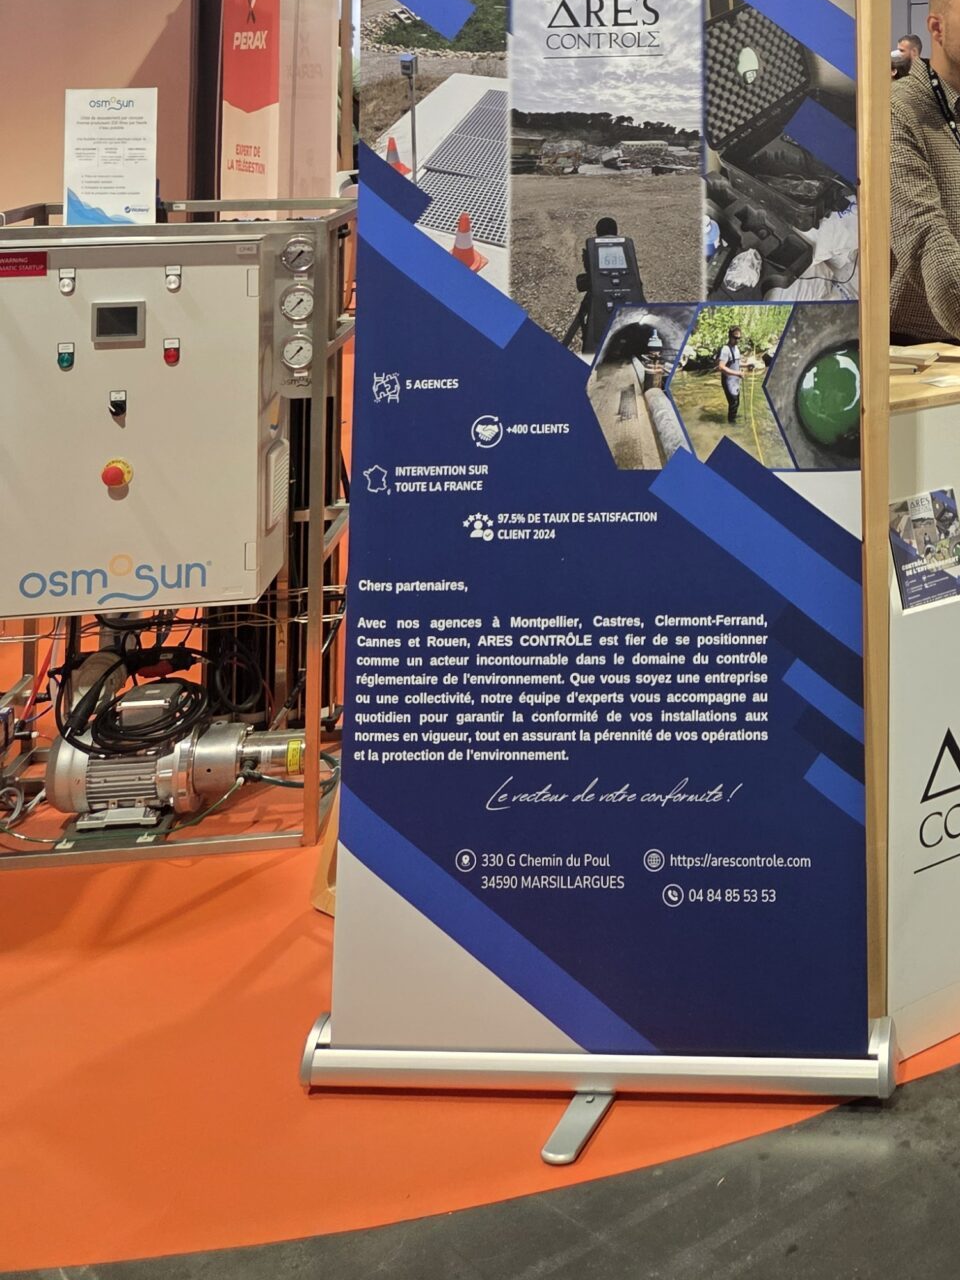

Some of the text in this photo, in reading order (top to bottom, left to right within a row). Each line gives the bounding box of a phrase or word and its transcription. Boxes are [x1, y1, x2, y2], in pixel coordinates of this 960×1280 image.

[232, 30, 268, 50] PERAX
[235, 144, 261, 158] EXPERT DE
[226, 159, 235, 170] LA
[405, 378, 459, 390] 5 AGENCES
[505, 423, 570, 435] +400 CLIENTS
[395, 464, 489, 477] INTERVENTION SUR
[394, 480, 483, 493] TOUTE LA FRANCE
[497, 511, 658, 524] 97.5% DE TAUX DE SATISFACTION
[497, 528, 556, 540] CLIENT 2024
[358, 579, 468, 595] Chers partenaires,
[356, 613, 768, 634] Avec nos agences à Montpellier, Castres, Clermont-Ferrand,
[356, 632, 769, 649] Cannes et Rouen, ARES CONTRÔLE est fier de se positionner
[356, 651, 768, 667] comme un acteur incontournable dans le domaine du contrôle
[355, 670, 768, 688] réglementaire de l'environnement. Que vous soyez une entreprise
[355, 691, 768, 707] ou une collectivité, notre équipe d'experts vous accompagne au
[354, 709, 769, 726] quotidien pour garantir la conformité de vos installations aux
[354, 728, 769, 745] normes en vigueur, tout en assurant la pérennité de vos opérations
[353, 748, 569, 764] et la protection de l'environnement.
[485, 775, 511, 811] Le
[511, 782, 568, 804] vecteur
[571, 777, 600, 804] de
[598, 783, 637, 804] votre
[640, 777, 724, 809] conformité
[481, 853, 611, 867] 330 G Chemin du Poul
[670, 853, 812, 870] https://arescontrole.com
[481, 875, 625, 889] 34590 MARSILLARGUES
[688, 888, 777, 903] 04 84 85 53 53
